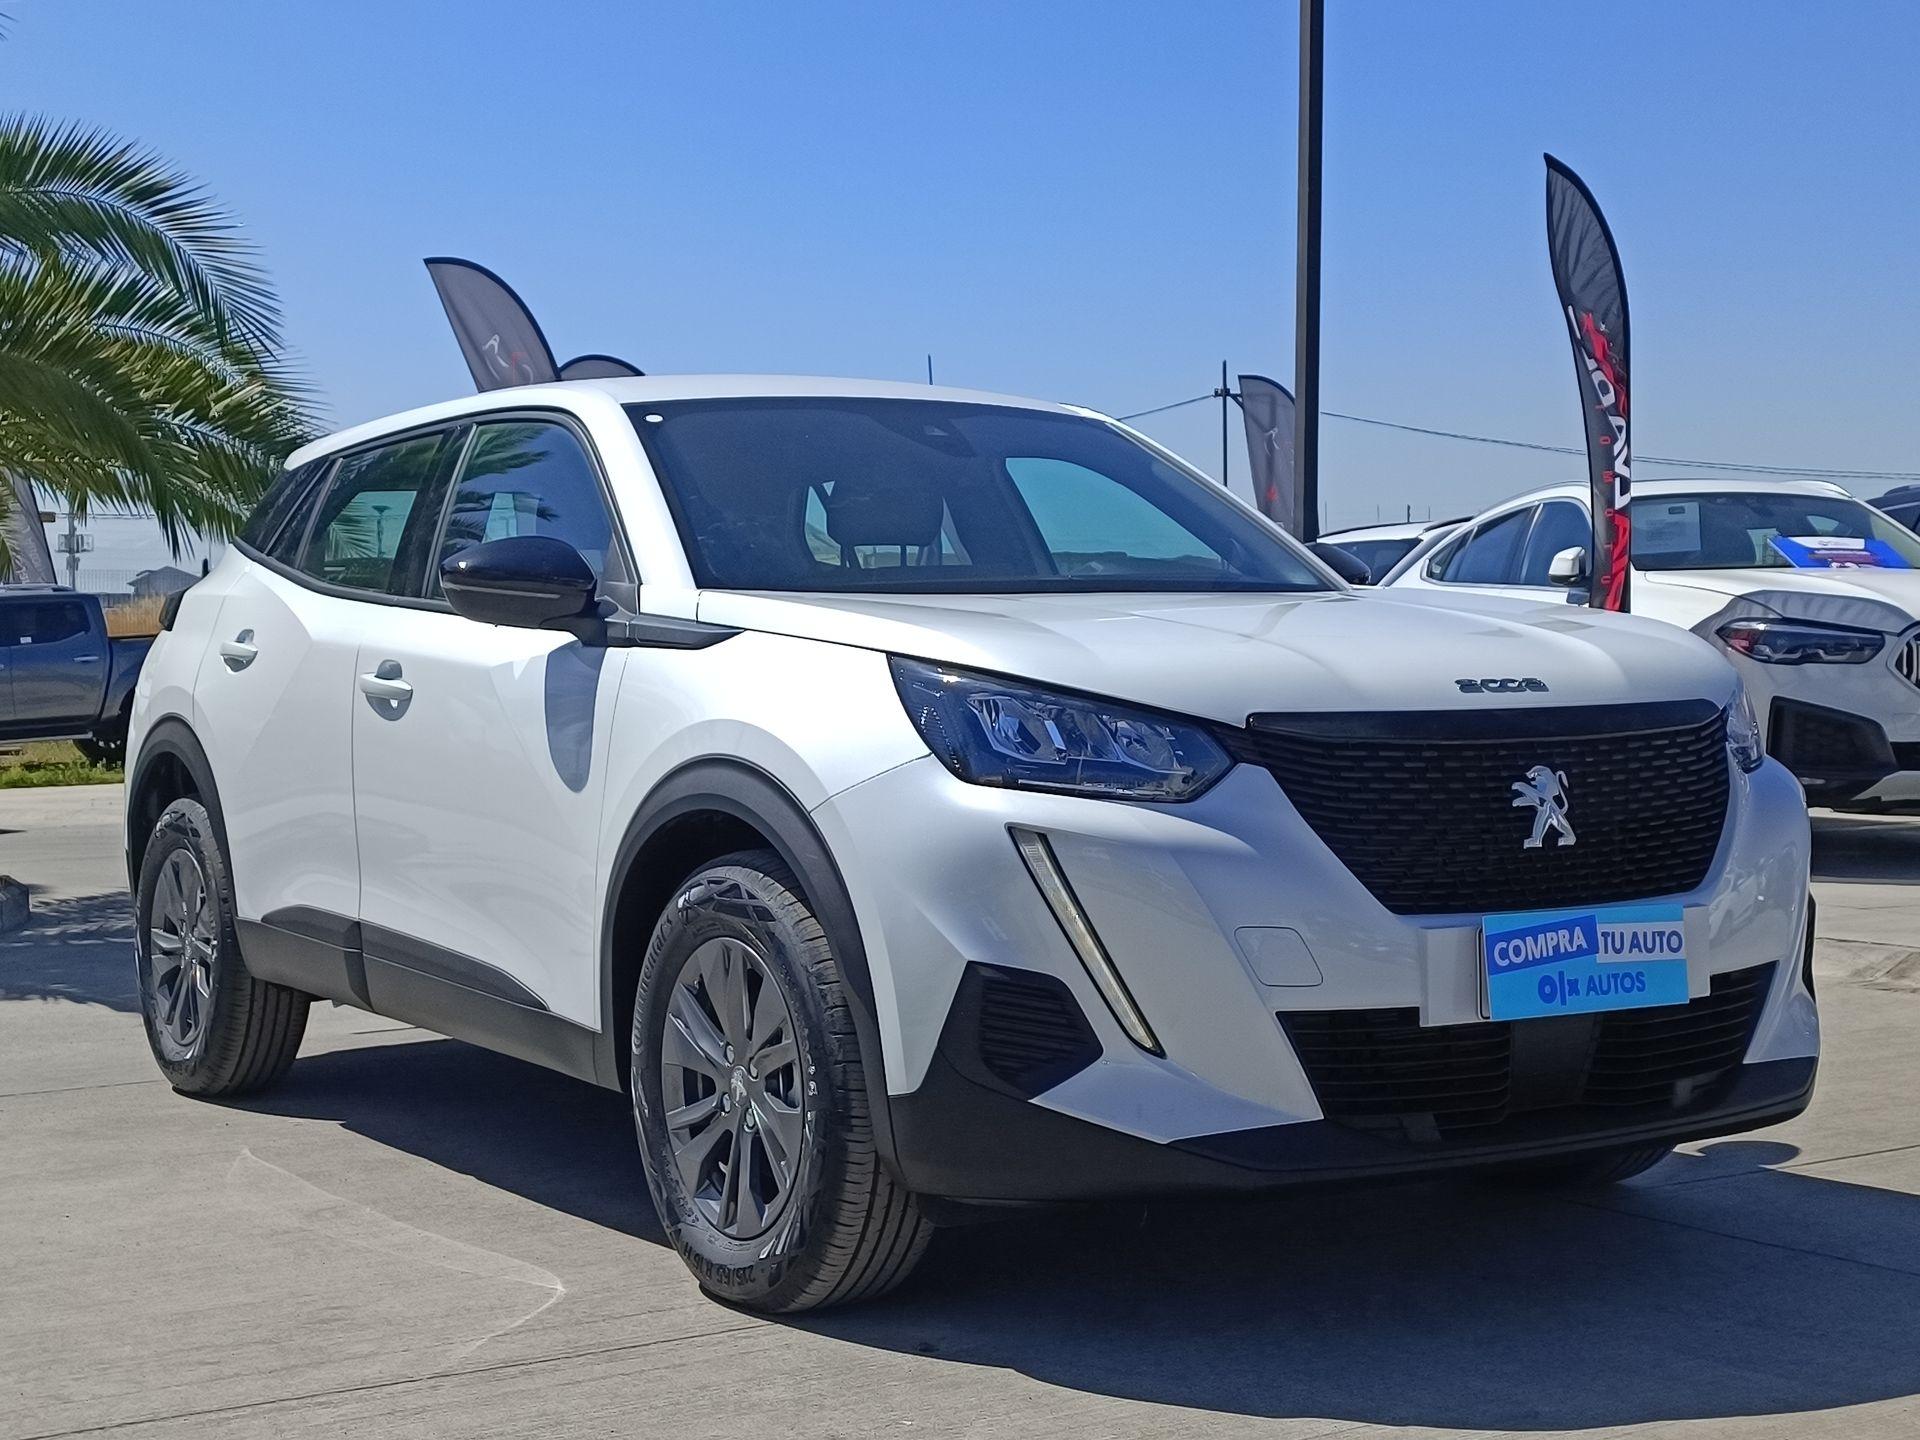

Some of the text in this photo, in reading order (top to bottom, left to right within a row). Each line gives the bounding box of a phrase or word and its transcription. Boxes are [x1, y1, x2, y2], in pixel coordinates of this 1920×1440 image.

[1493, 926, 1683, 967] COMPRA TU AUTO
[1586, 971, 1646, 996] AUTOS
